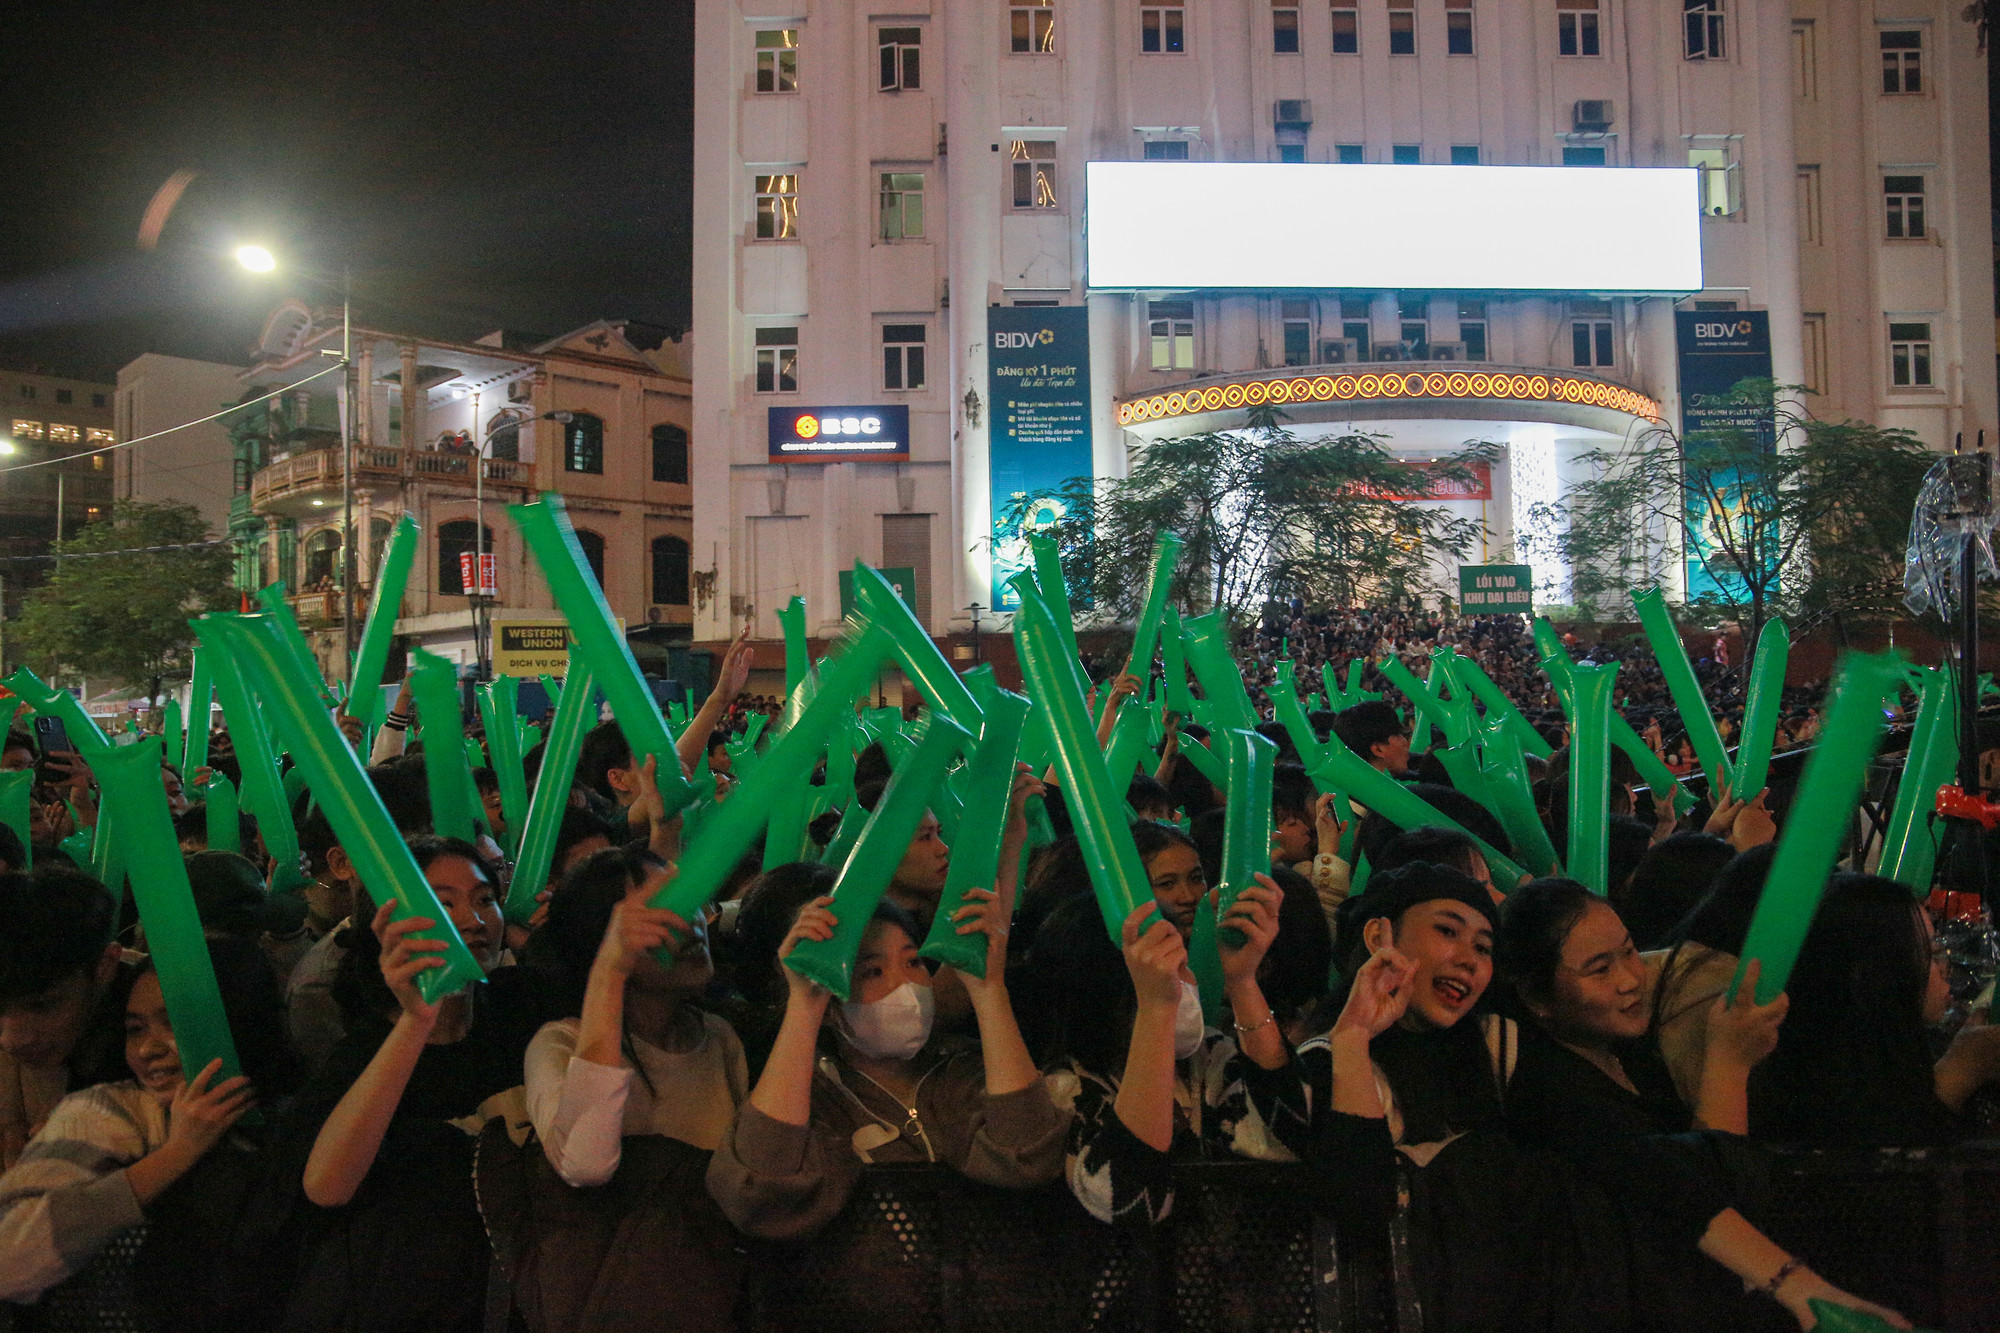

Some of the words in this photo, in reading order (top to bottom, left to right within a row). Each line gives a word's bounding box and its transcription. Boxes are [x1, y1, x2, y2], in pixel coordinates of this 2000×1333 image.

[1695, 323, 1737, 338] BIDV
[995, 332, 1039, 348] BIDV
[997, 366, 1024, 376] ĐĂNG
[1025, 366, 1038, 376] KÝ
[1041, 365, 1047, 376] 1
[1050, 366, 1077, 376] PHÚT
[1476, 573, 1493, 588] LỐI
[1494, 574, 1516, 588] VÀO
[1464, 592, 1485, 604] KHU
[1487, 592, 1504, 605] ĐẠI
[508, 629, 563, 639] WESTERN
[522, 639, 563, 648] UNION
[510, 659, 532, 669] DỊCH
[535, 659, 548, 669] VỤ
